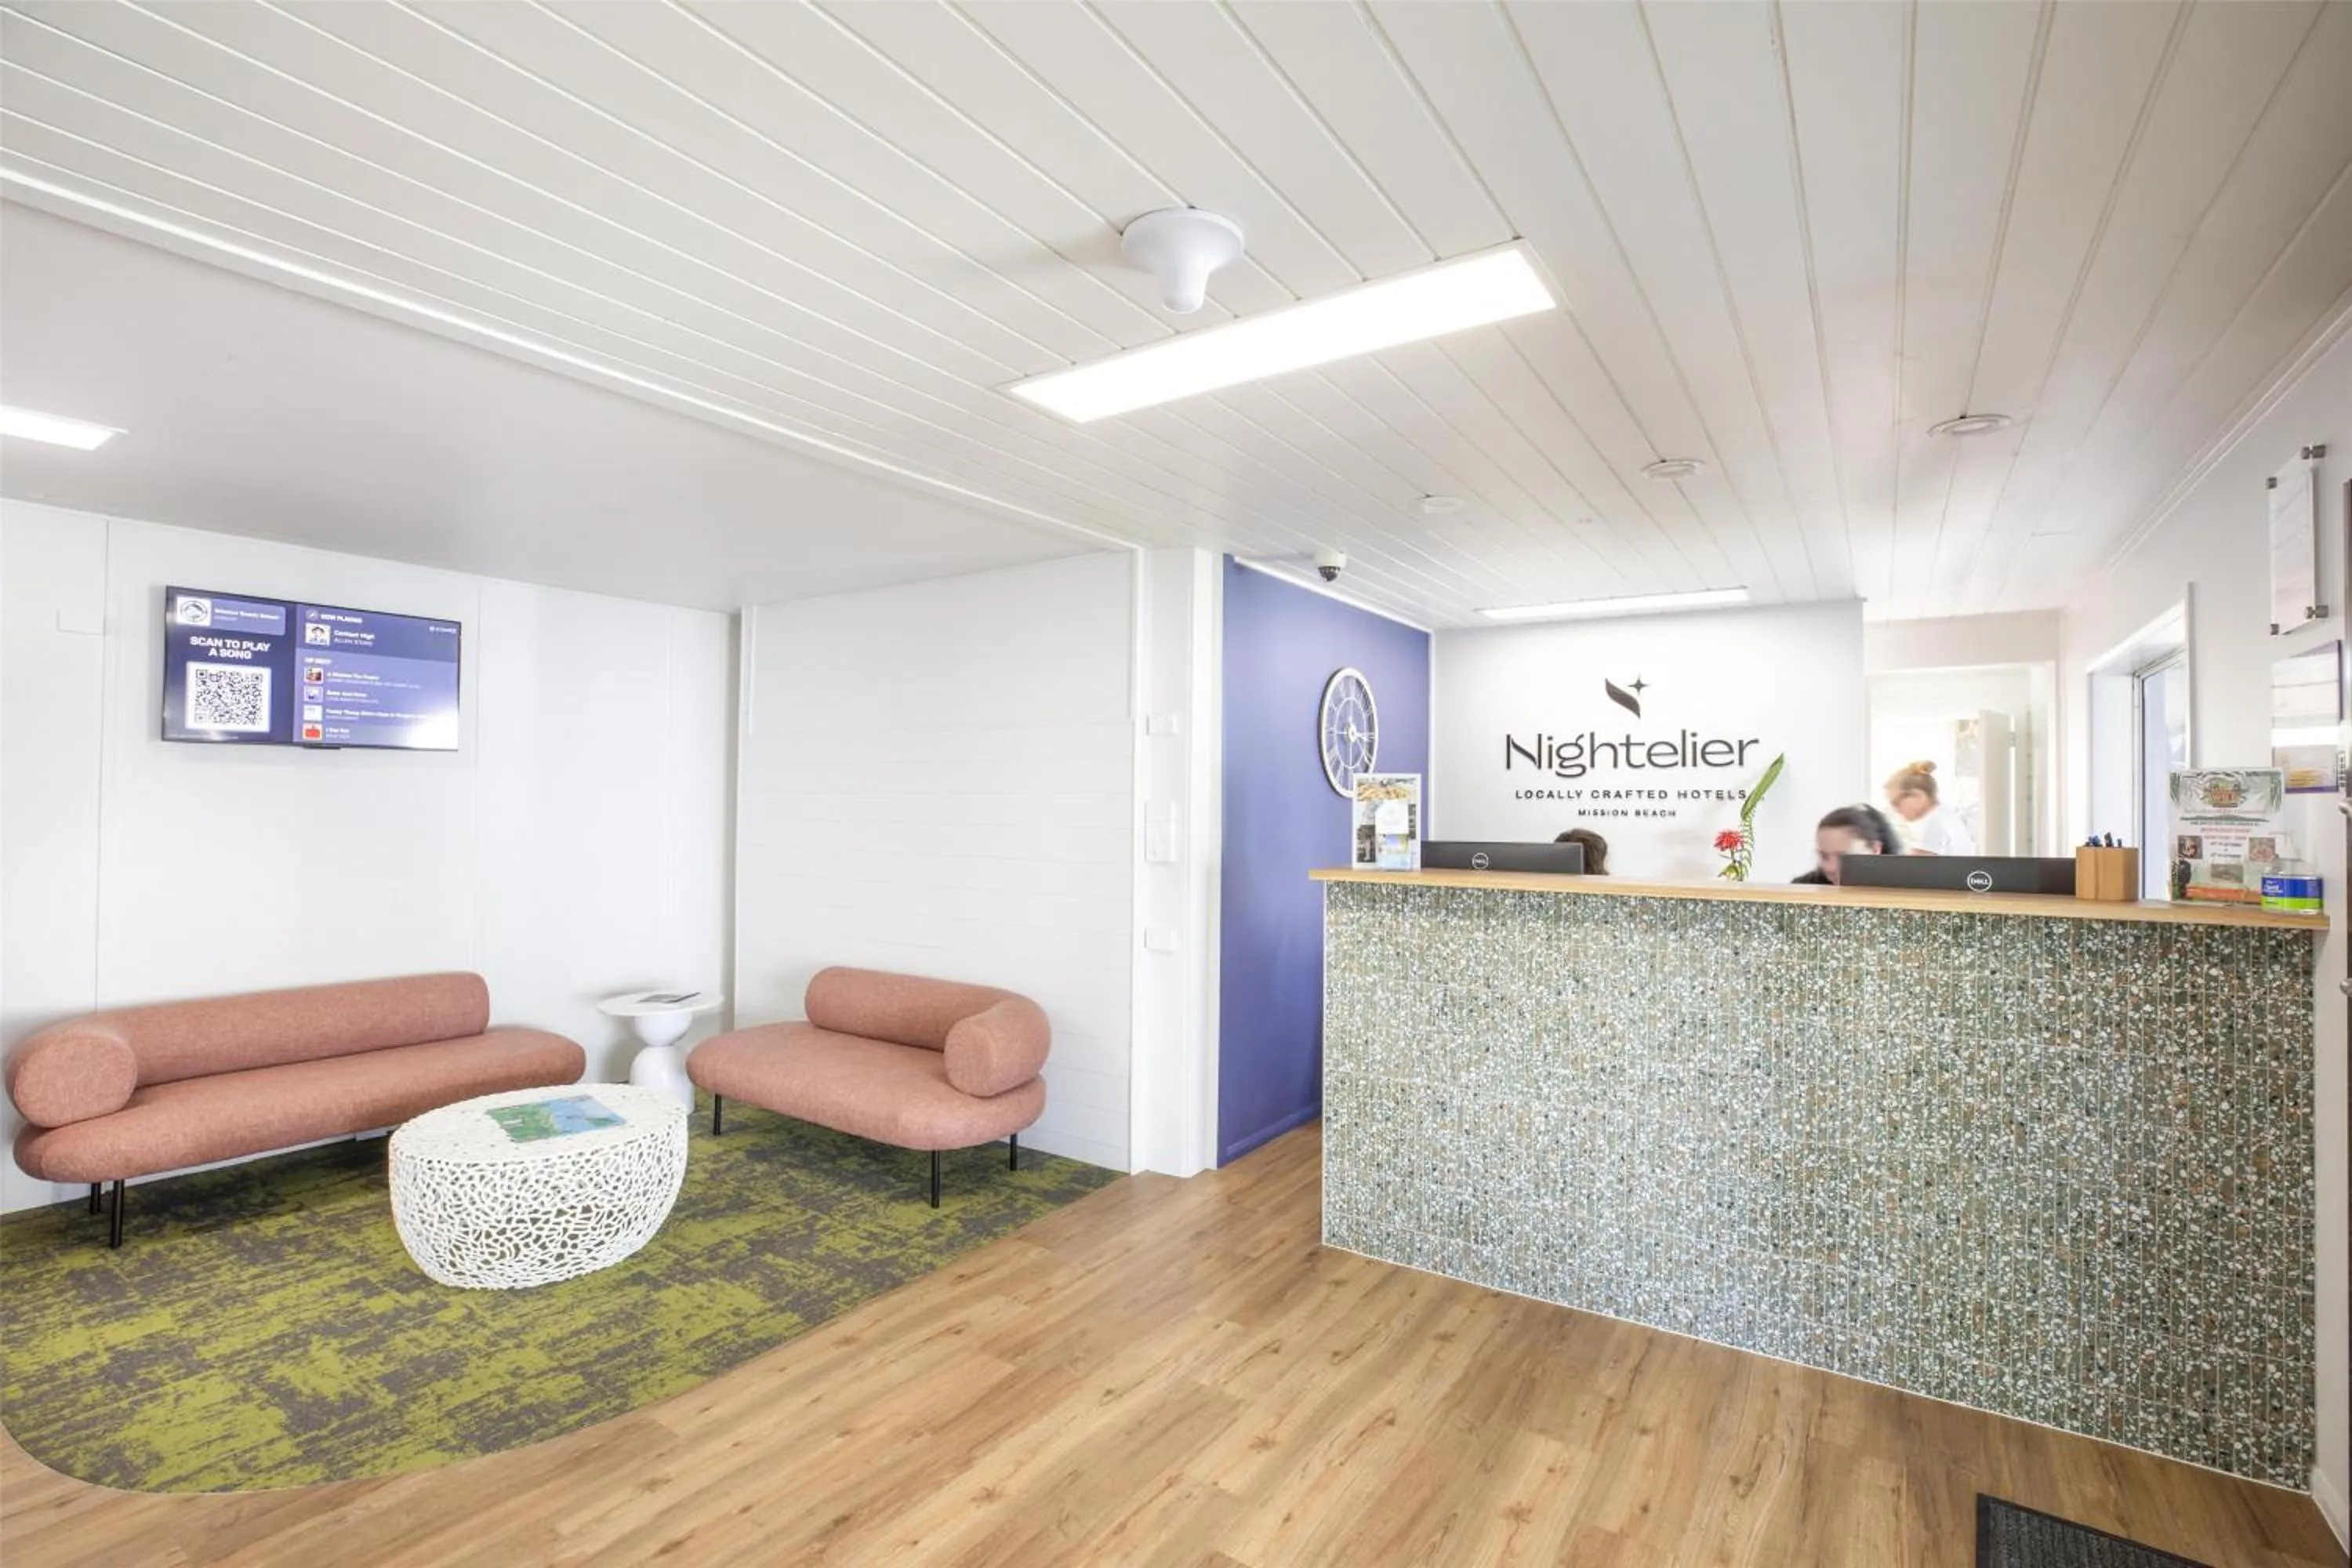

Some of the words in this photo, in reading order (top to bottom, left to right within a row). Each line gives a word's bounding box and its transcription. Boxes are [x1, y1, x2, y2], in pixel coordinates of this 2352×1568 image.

[190, 636, 223, 648] SCAN
[225, 639, 240, 649] TO
[242, 641, 271, 652] PLAY
[208, 648, 217, 657] A
[219, 648, 252, 659] SONG
[1505, 729, 1760, 779] Nightelier
[1515, 789, 1583, 800] LOCALLY
[1591, 789, 1668, 800] CRAFTED
[1677, 789, 1747, 800] HOTELS
[1577, 808, 1628, 817] MISSION
[1635, 808, 1677, 818] BEACH
[1970, 877, 1989, 886] DELL
